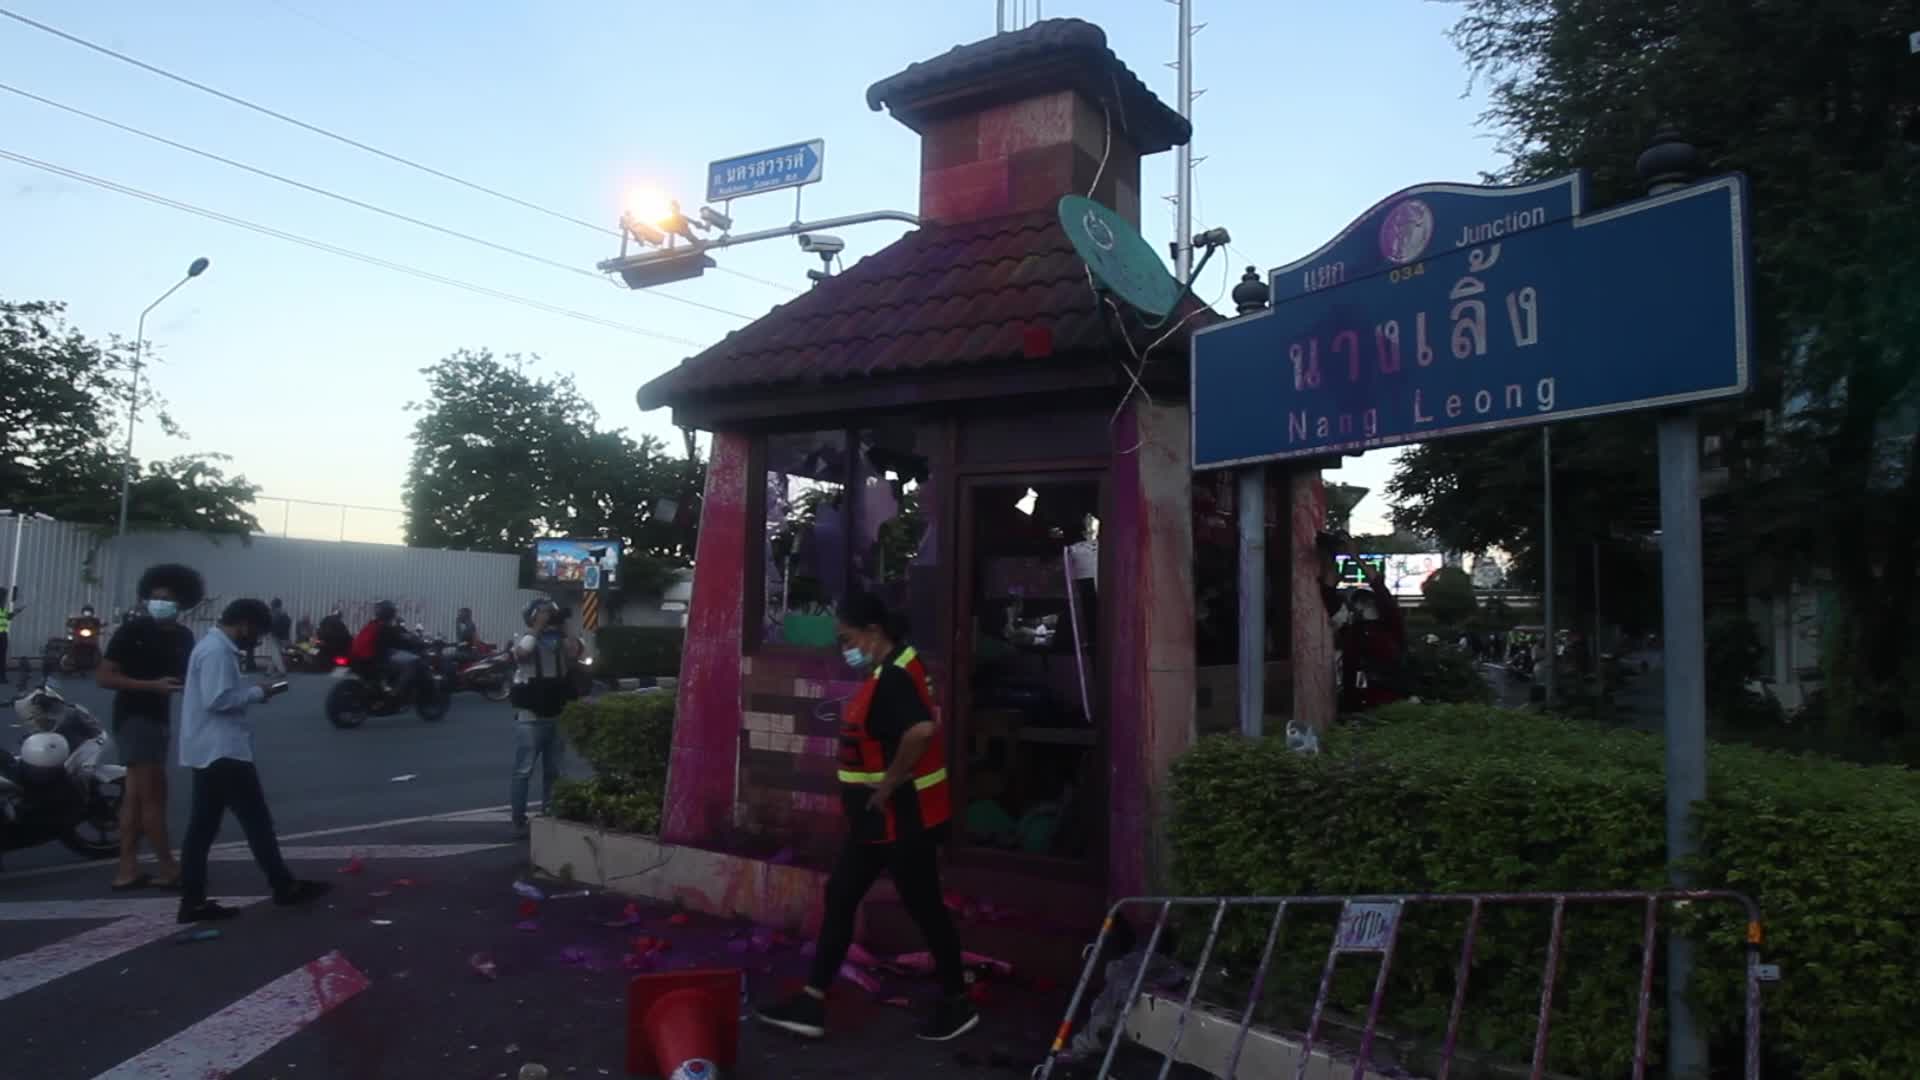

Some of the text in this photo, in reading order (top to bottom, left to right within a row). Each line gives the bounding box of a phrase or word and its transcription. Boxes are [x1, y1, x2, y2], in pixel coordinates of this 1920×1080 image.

[1456, 207, 1545, 246] Junction
[1303, 261, 1345, 292] แยก
[1389, 263, 1425, 284] 034
[1289, 244, 1539, 391] นางเลิ้ง
[1288, 377, 1556, 443] Nang Leong
